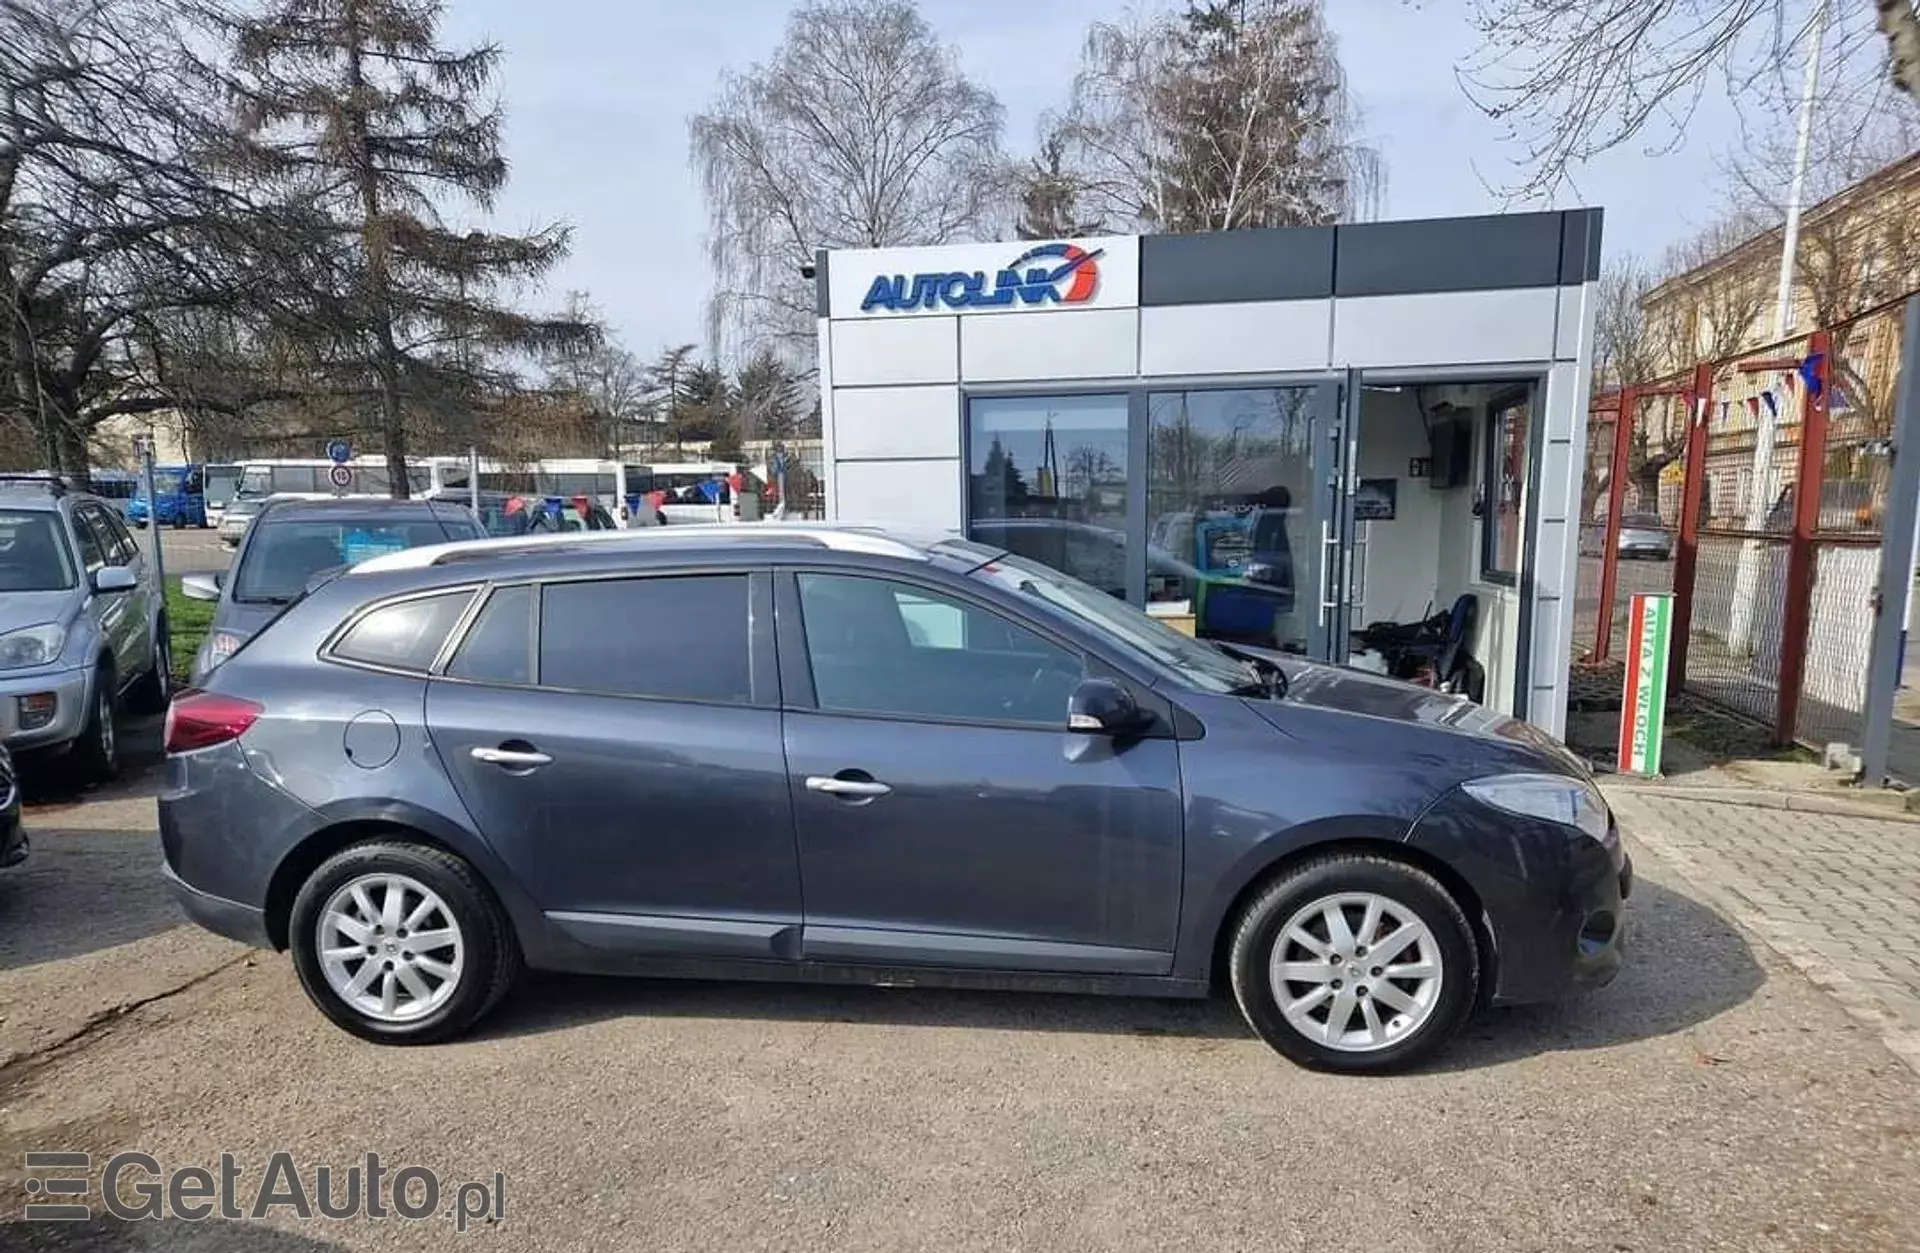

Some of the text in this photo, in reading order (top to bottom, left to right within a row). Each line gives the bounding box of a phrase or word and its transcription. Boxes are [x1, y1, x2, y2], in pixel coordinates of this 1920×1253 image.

[860, 267, 1064, 311] AUTOLINK
[1643, 608, 1655, 658] AUTA
[1641, 666, 1651, 678] Z
